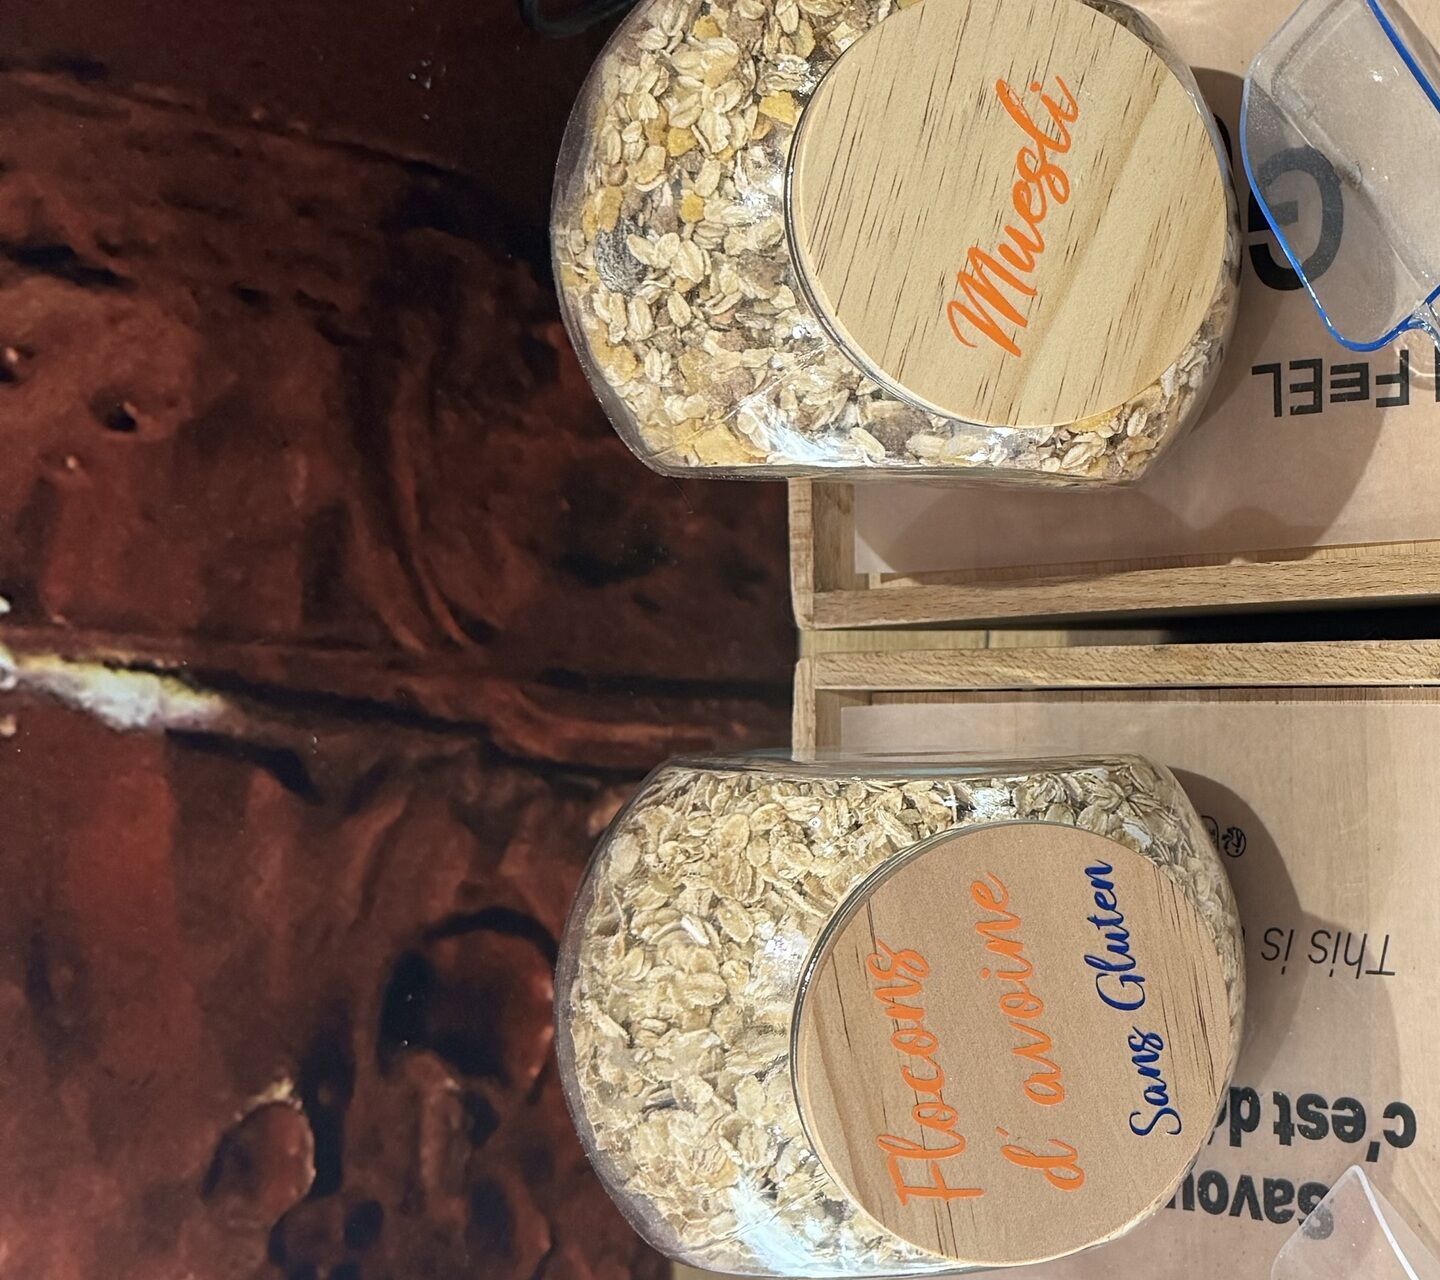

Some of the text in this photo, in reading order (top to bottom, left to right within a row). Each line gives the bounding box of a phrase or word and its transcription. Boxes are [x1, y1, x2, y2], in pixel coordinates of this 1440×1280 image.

[946, 75, 1080, 358] Muesli
[1250, 349, 1410, 418] FEEL
[1081, 858, 1182, 1137] Sans Gluten
[1260, 926, 1396, 980] This is
[863, 938, 988, 1206] Flocons
[1272, 1092, 1417, 1163] c'est
